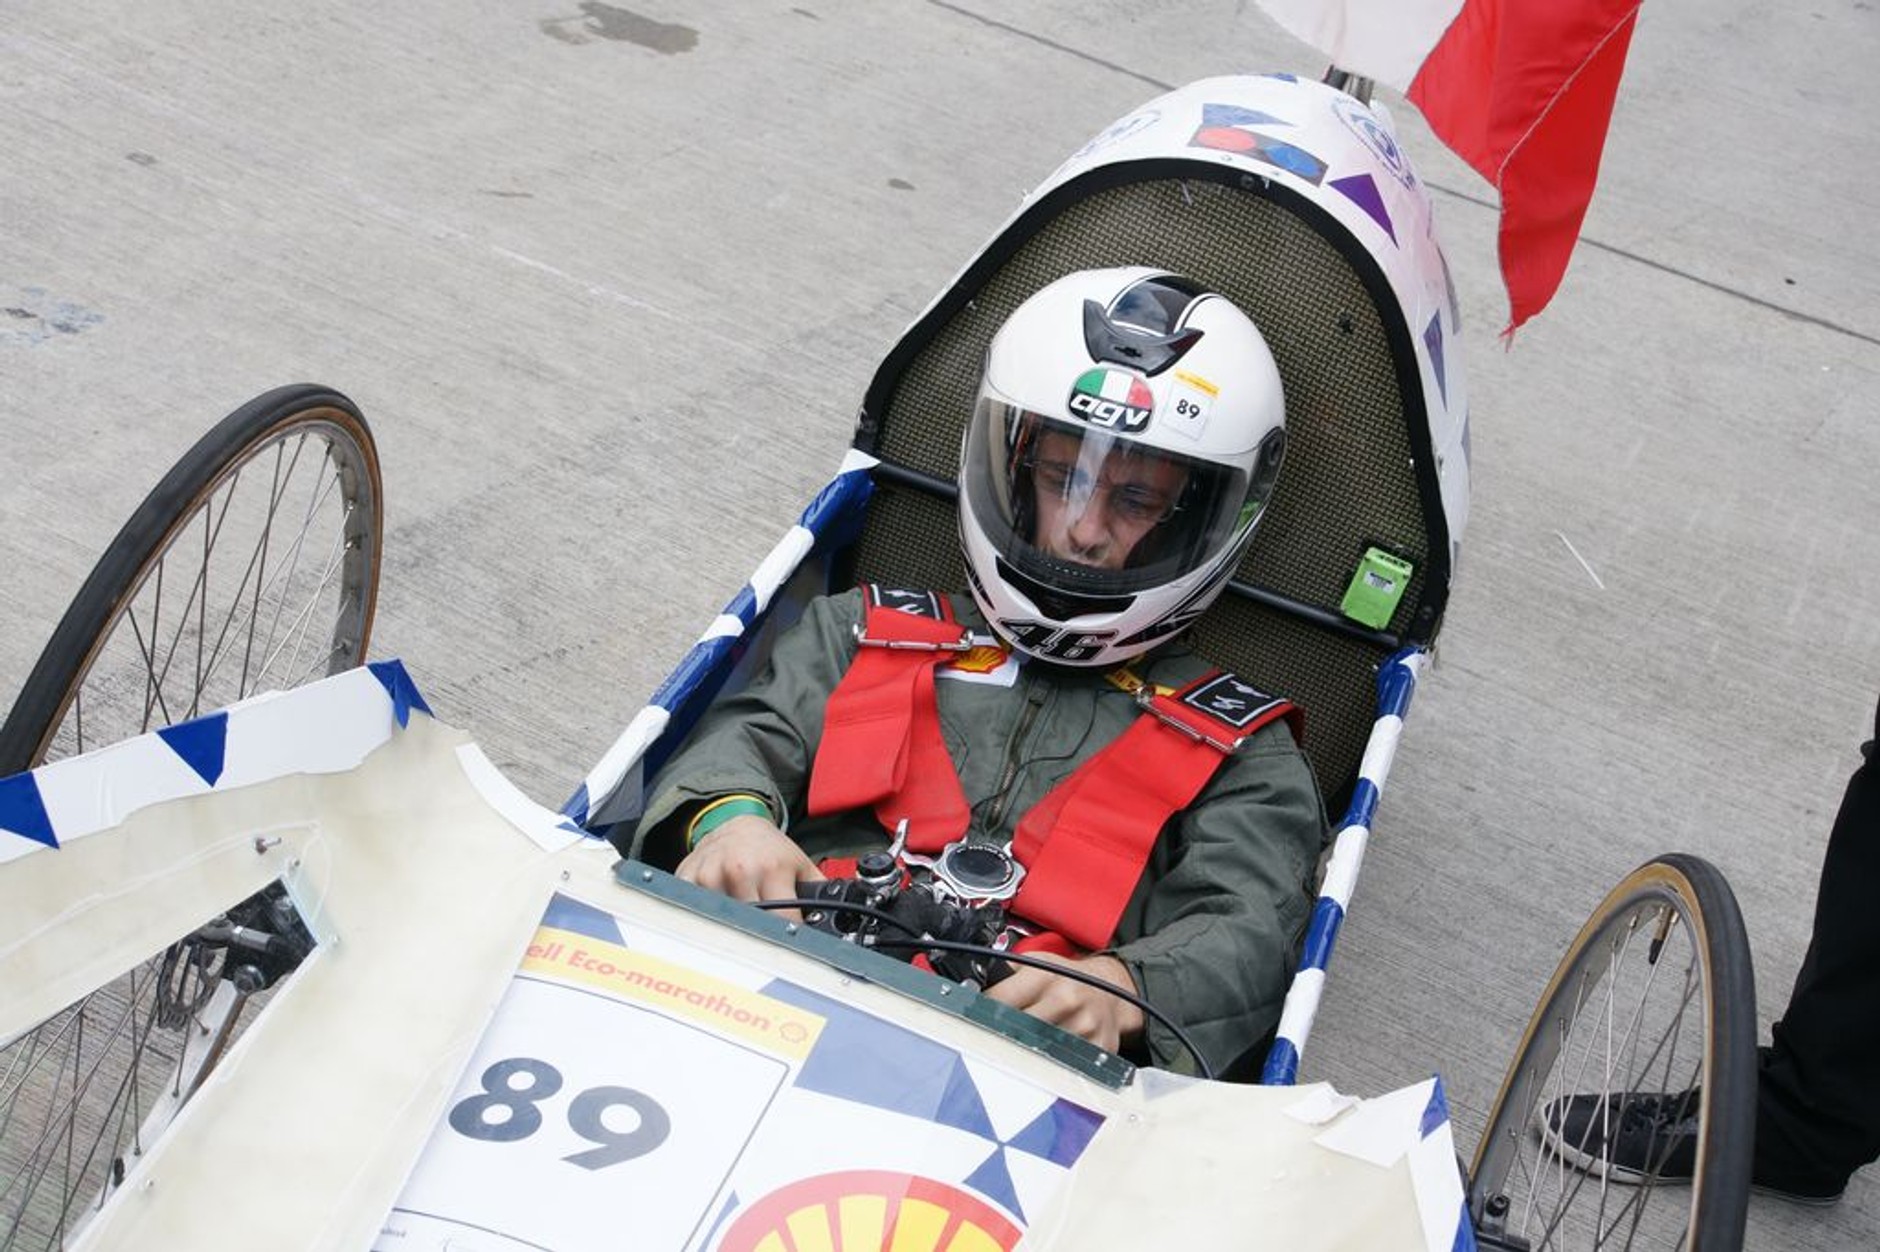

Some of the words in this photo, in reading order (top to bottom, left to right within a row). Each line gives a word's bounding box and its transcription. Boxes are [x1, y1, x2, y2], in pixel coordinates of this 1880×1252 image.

[1070, 393, 1150, 428] agv
[1176, 398, 1201, 419] 89
[996, 617, 1119, 663] 46
[566, 948, 772, 1032] Eco-marathon
[448, 1056, 672, 1172] 89
